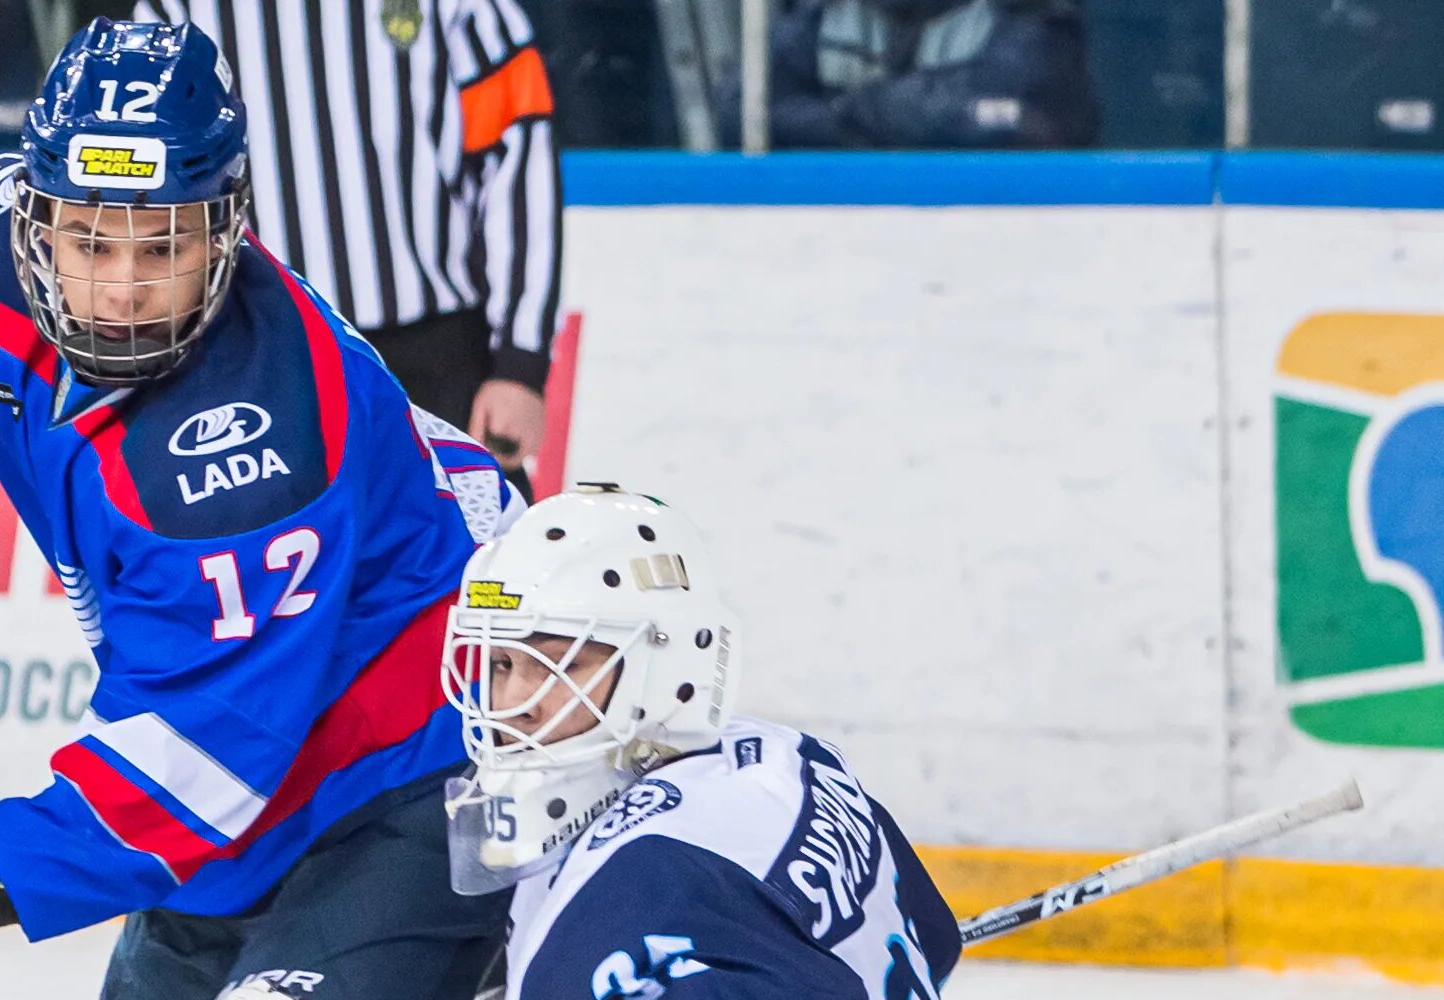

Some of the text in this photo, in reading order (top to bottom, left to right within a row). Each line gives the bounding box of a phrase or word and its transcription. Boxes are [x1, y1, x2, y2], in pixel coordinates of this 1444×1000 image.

[94, 79, 158, 123] 12
[176, 448, 292, 505] LADA
[199, 526, 322, 641] 12
